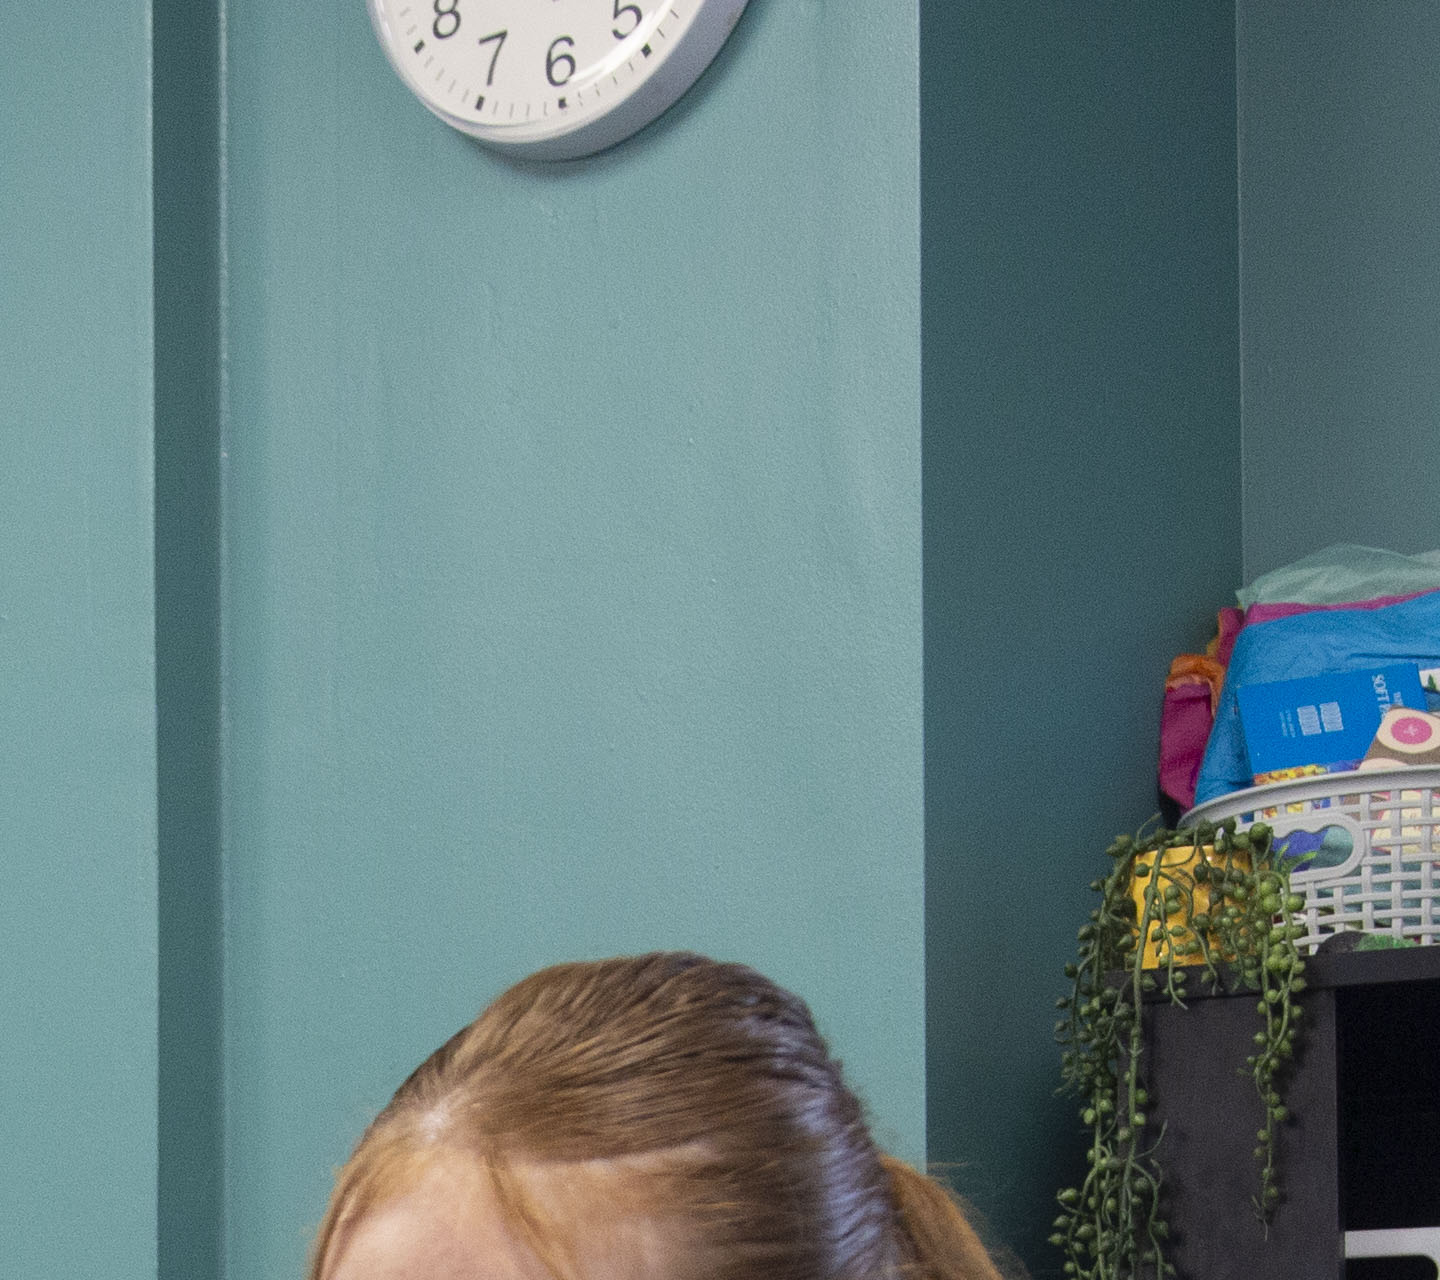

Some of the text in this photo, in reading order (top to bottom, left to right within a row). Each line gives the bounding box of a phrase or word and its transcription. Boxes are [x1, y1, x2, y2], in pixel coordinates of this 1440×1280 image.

[431, 0, 463, 41] 8
[611, 0, 644, 41] 5
[477, 30, 510, 88] 7
[544, 35, 578, 88] 6
